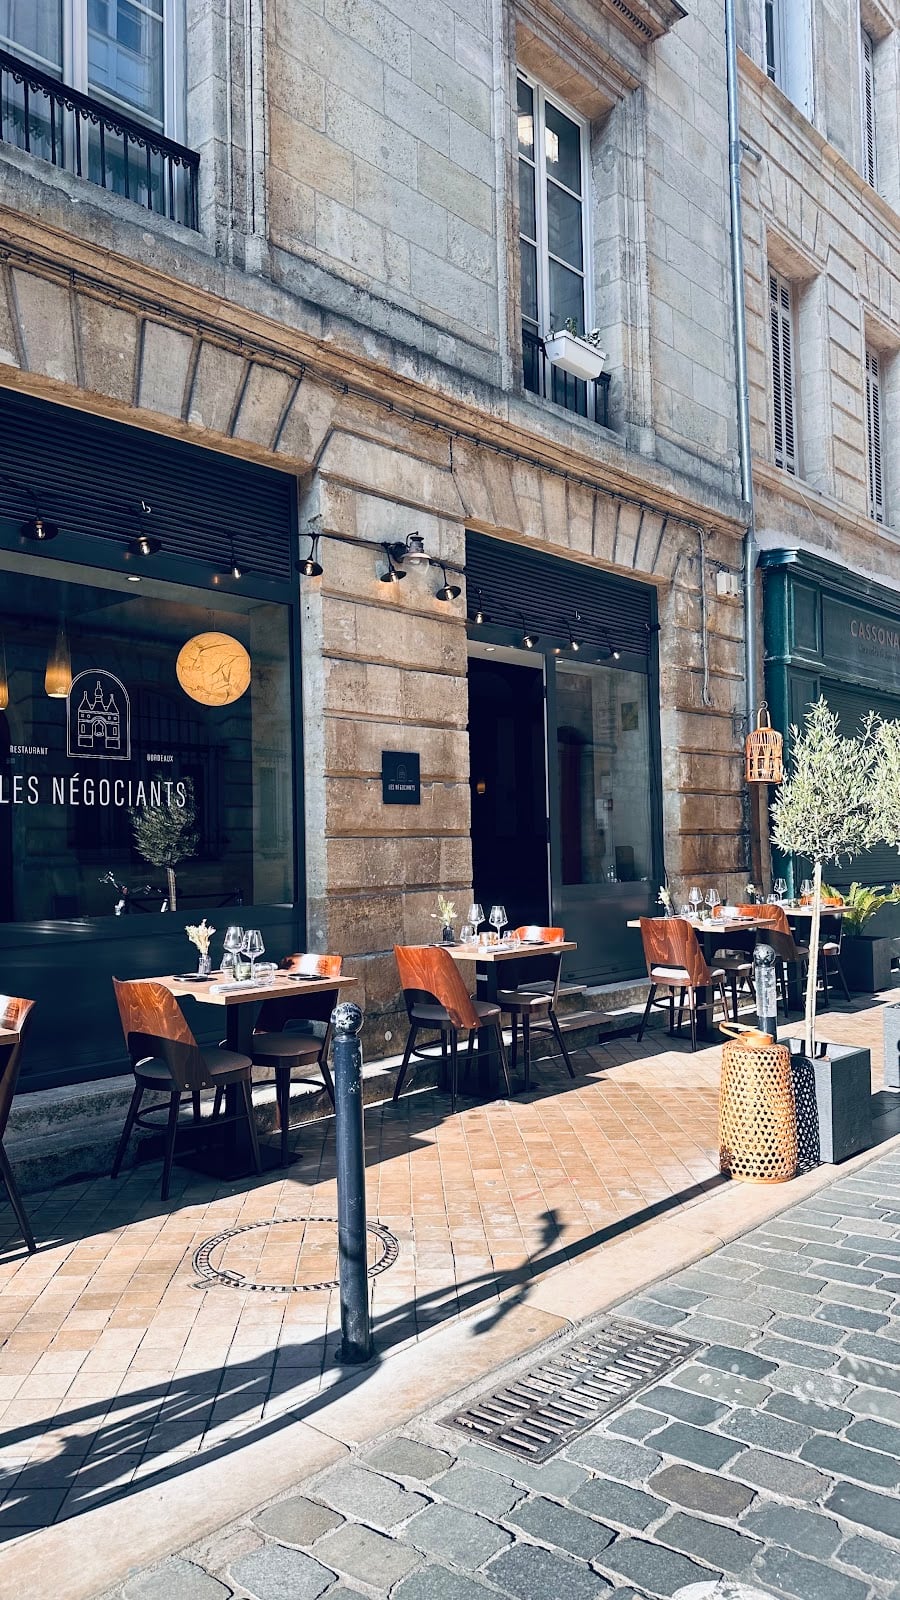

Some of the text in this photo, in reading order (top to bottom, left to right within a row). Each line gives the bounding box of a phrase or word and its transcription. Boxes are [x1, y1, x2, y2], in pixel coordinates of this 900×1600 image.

[851, 620, 900, 650] CASSONA
[10, 745, 48, 755] RESTAURANT
[147, 753, 174, 762] BORDEAUX
[0, 773, 186, 808] LES NÉGOCIANTS
